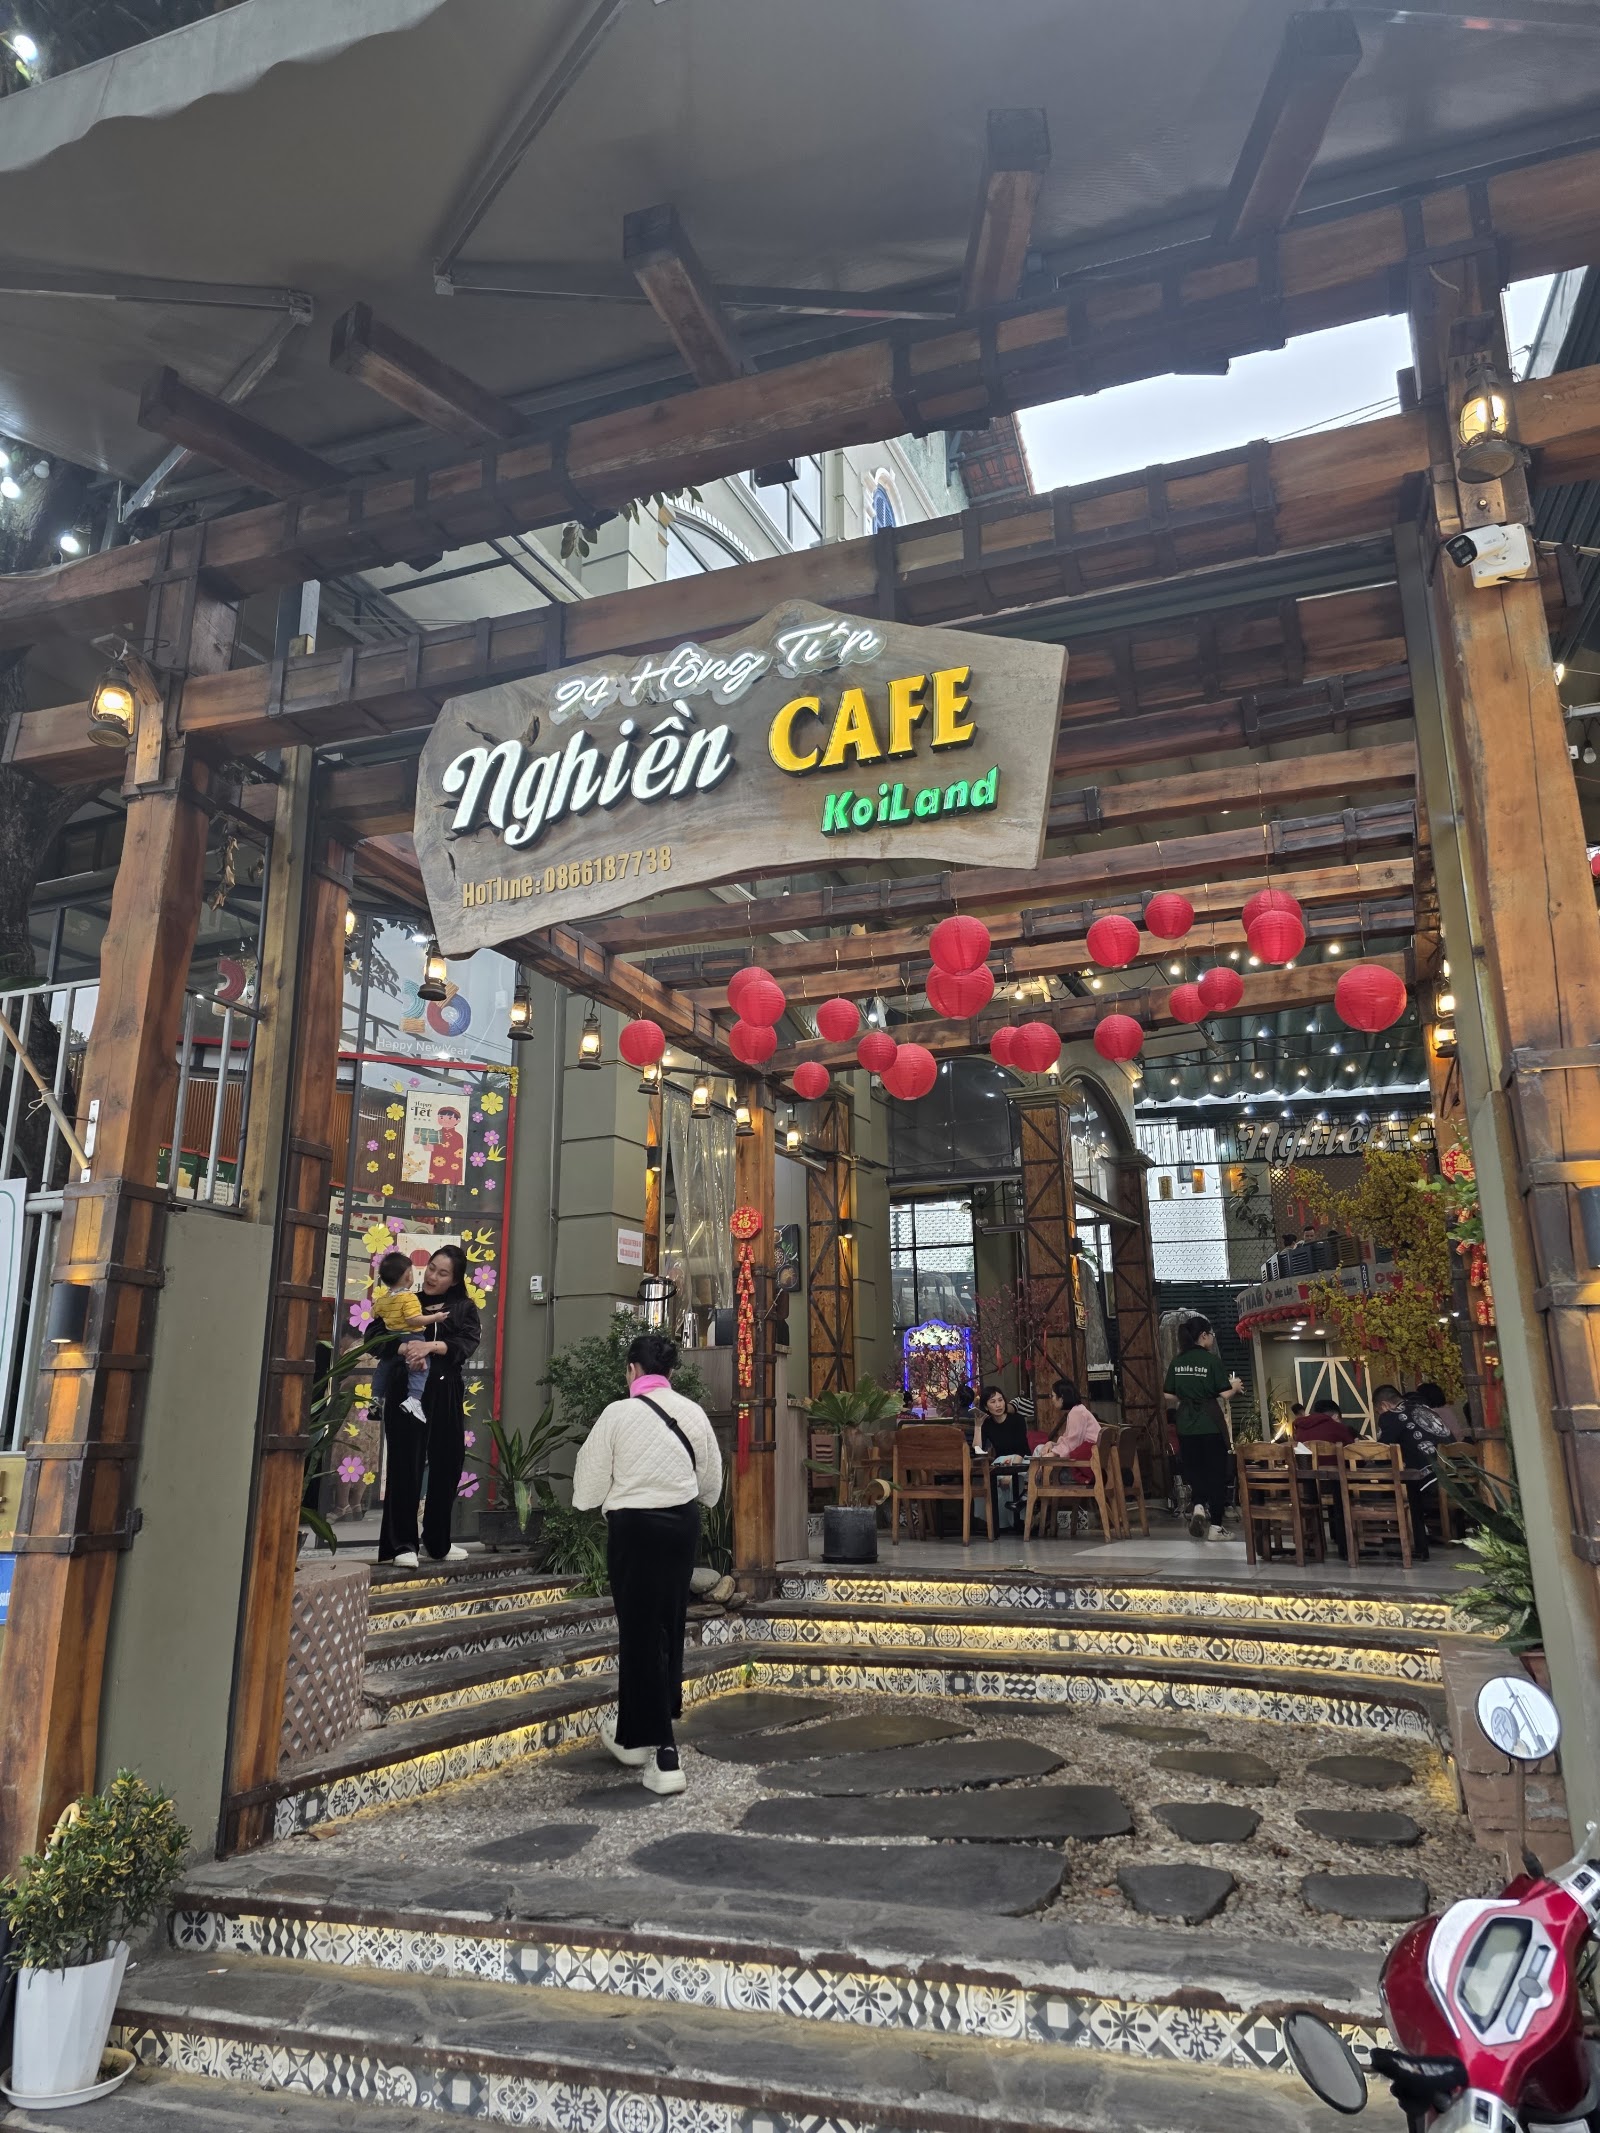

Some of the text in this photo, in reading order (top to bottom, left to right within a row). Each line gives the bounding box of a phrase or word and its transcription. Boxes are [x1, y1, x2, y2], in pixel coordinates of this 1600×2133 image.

[557, 622, 880, 713] 94 Hồng Tiến
[768, 666, 977, 774] CAFE
[442, 699, 735, 848] Nghiền
[821, 765, 1000, 835] KoiLand
[377, 1038, 469, 1056] Happy New Year
